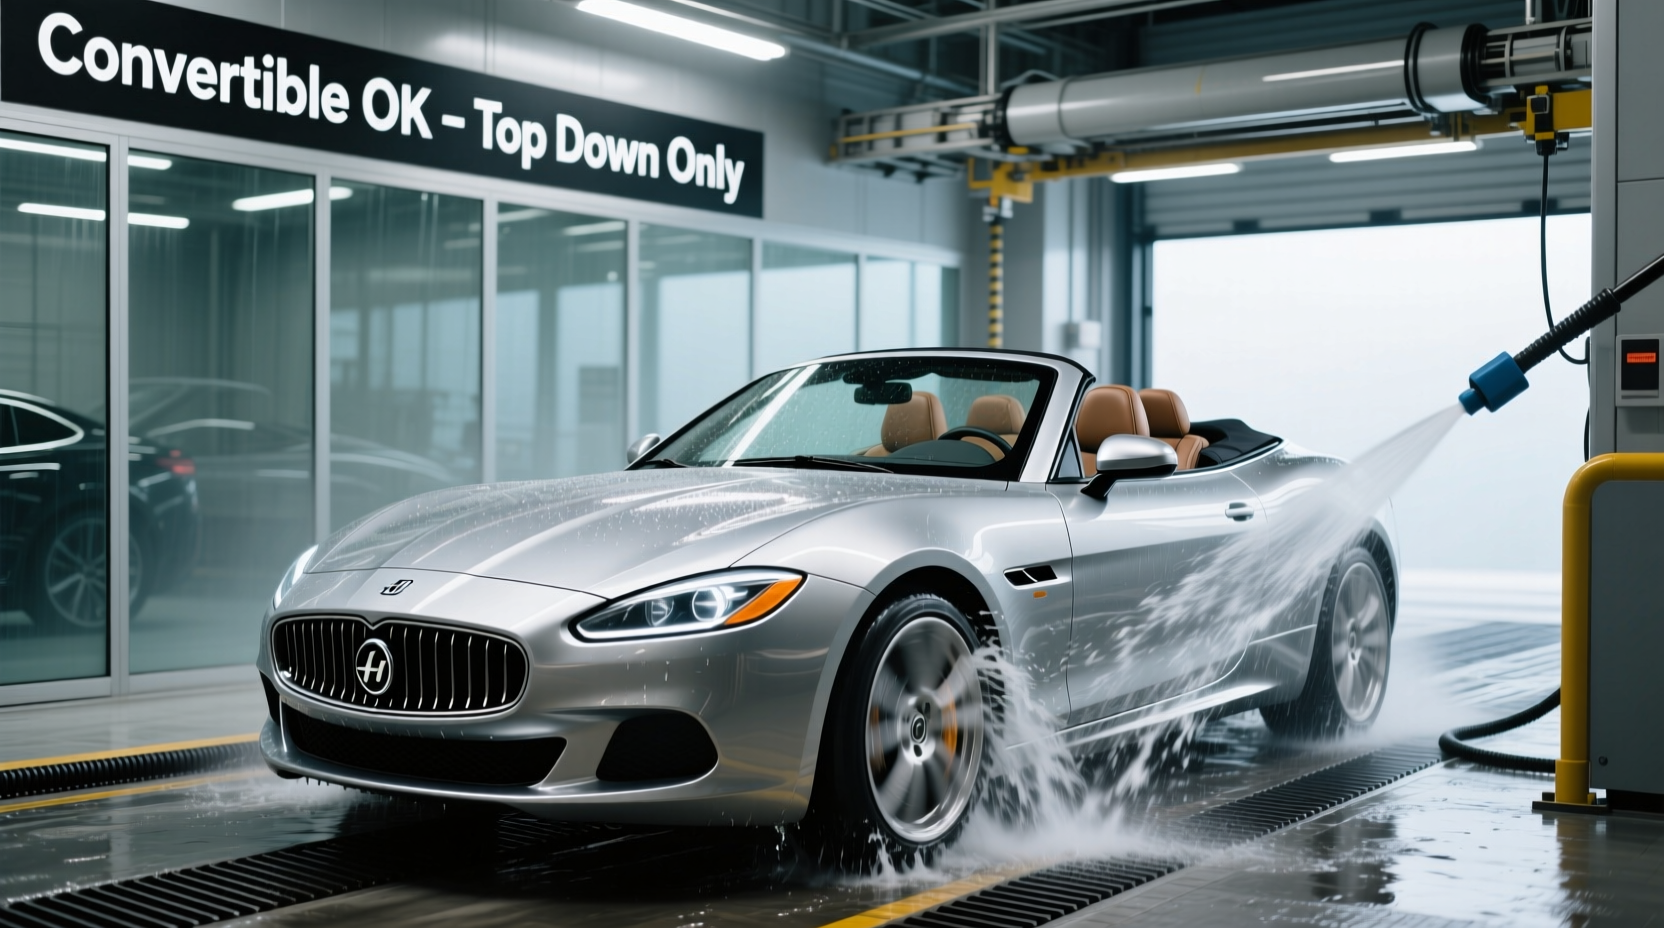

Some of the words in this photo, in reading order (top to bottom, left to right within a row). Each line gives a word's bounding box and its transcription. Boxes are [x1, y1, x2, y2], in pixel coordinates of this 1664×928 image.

[37, 12, 350, 124] Convertible
[361, 77, 433, 140] OK
[473, 97, 548, 171] Top
[555, 113, 660, 179] Down
[666, 135, 745, 205] Only
